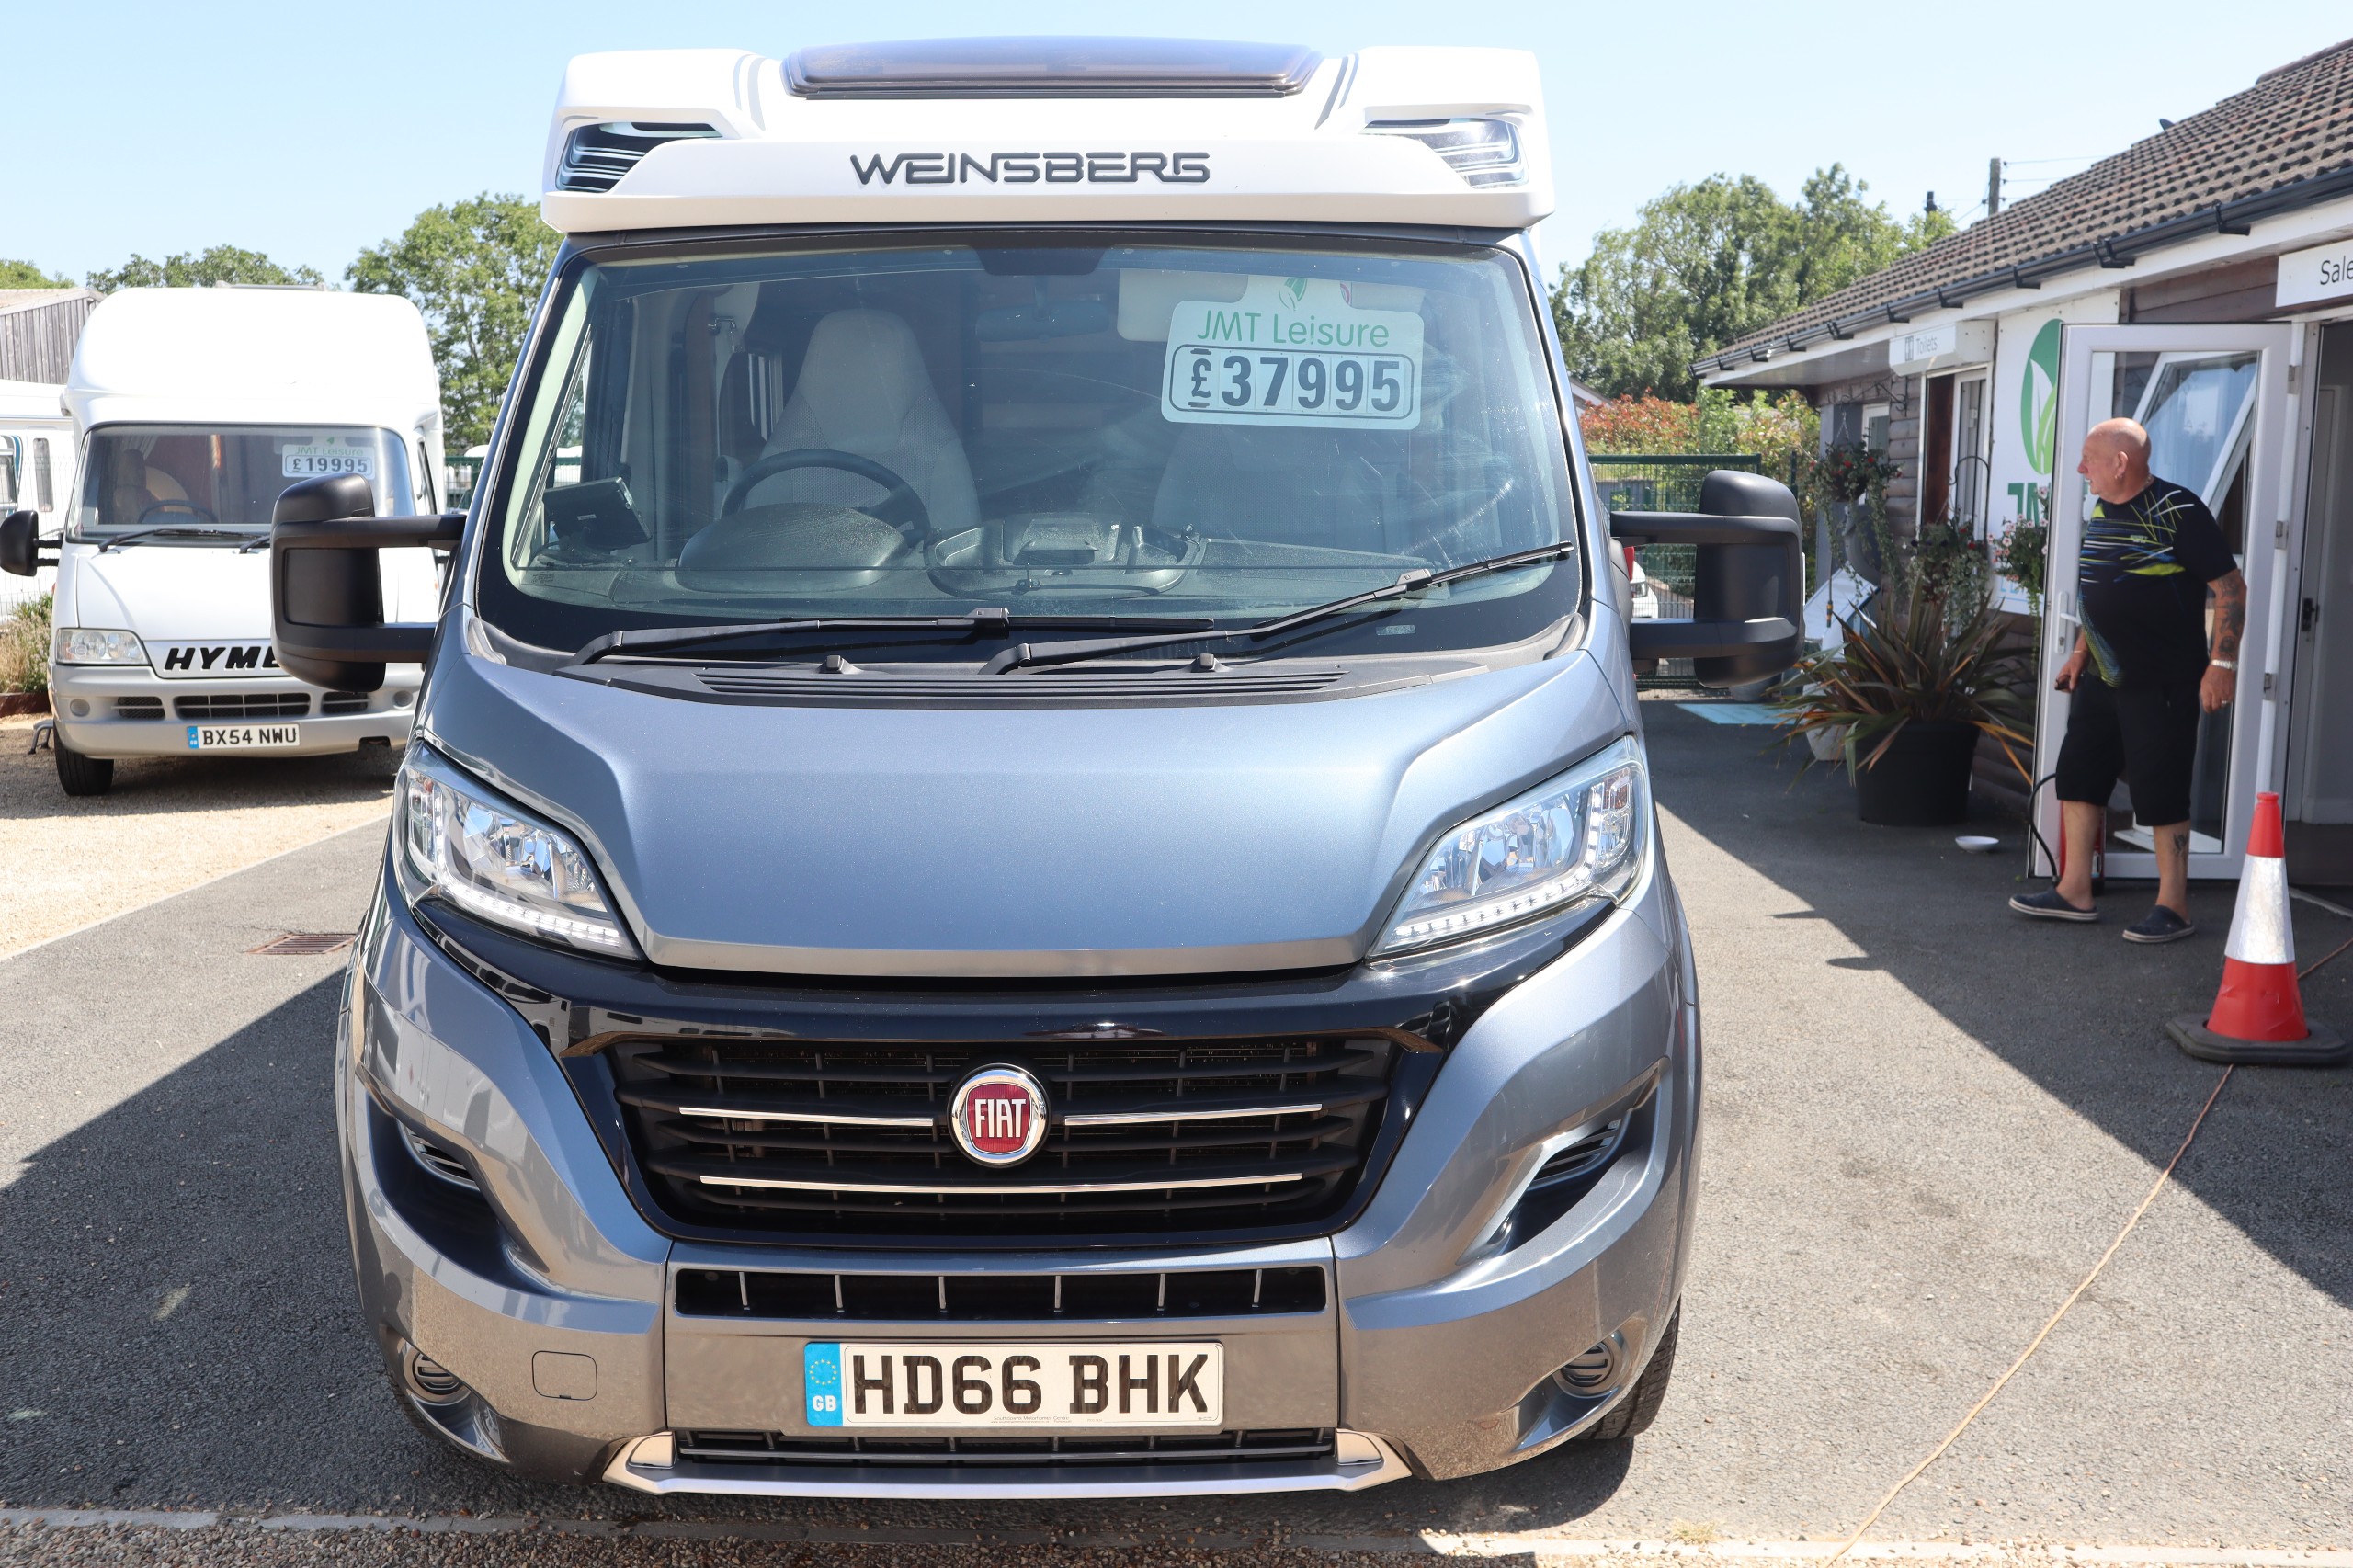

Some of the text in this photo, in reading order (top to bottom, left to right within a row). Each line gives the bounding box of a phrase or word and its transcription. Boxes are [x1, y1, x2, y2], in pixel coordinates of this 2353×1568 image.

[849, 151, 1211, 186] WEINSBERG
[1197, 310, 1390, 347] JMT Leisure
[1915, 335, 1938, 356] Toilets
[1190, 355, 1401, 412] £37995
[292, 457, 368, 473] £19995
[295, 446, 364, 457] JMT Leisure
[201, 727, 297, 745] BX54 NWU
[974, 1098, 1027, 1138] FIAT
[852, 1353, 1209, 1415] HD66 BHK
[812, 1394, 837, 1413] GB
